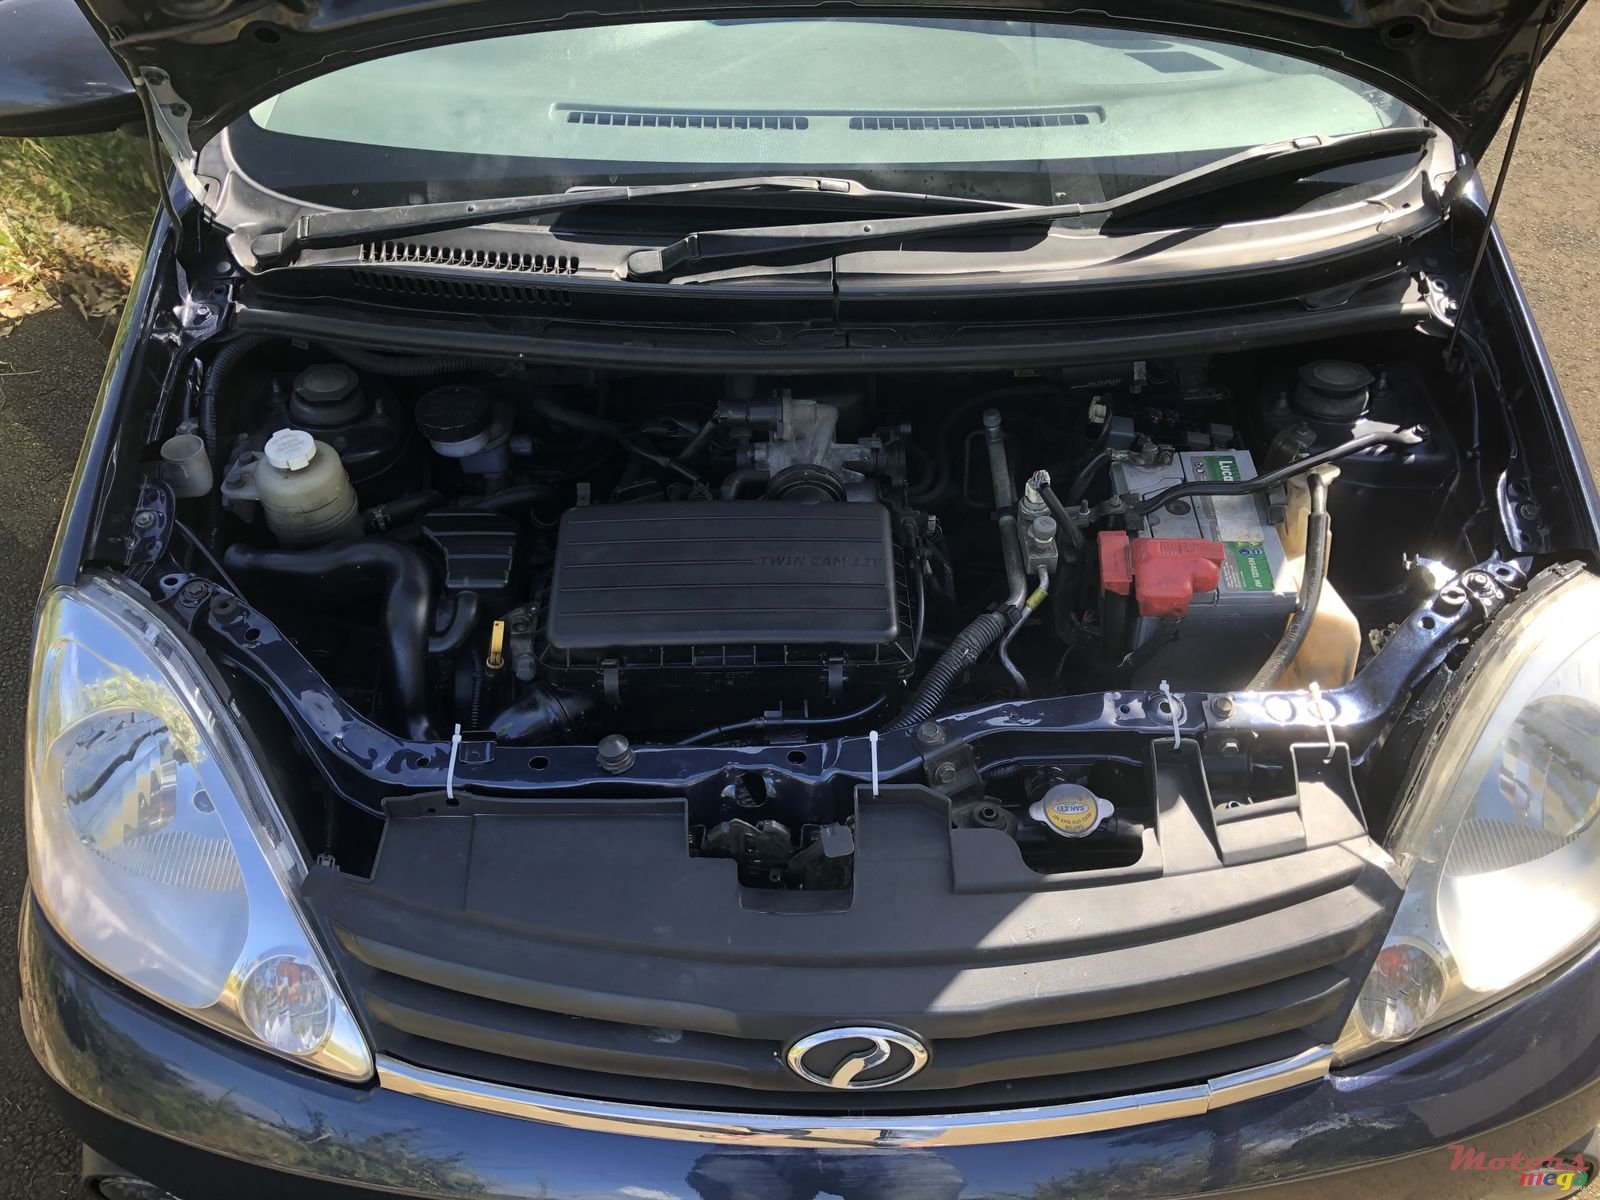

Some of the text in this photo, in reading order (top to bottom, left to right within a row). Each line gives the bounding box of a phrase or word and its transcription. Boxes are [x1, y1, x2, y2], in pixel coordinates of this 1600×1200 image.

[1219, 460, 1233, 481] Luca
[760, 556, 883, 567] TWIN CAM 12V
